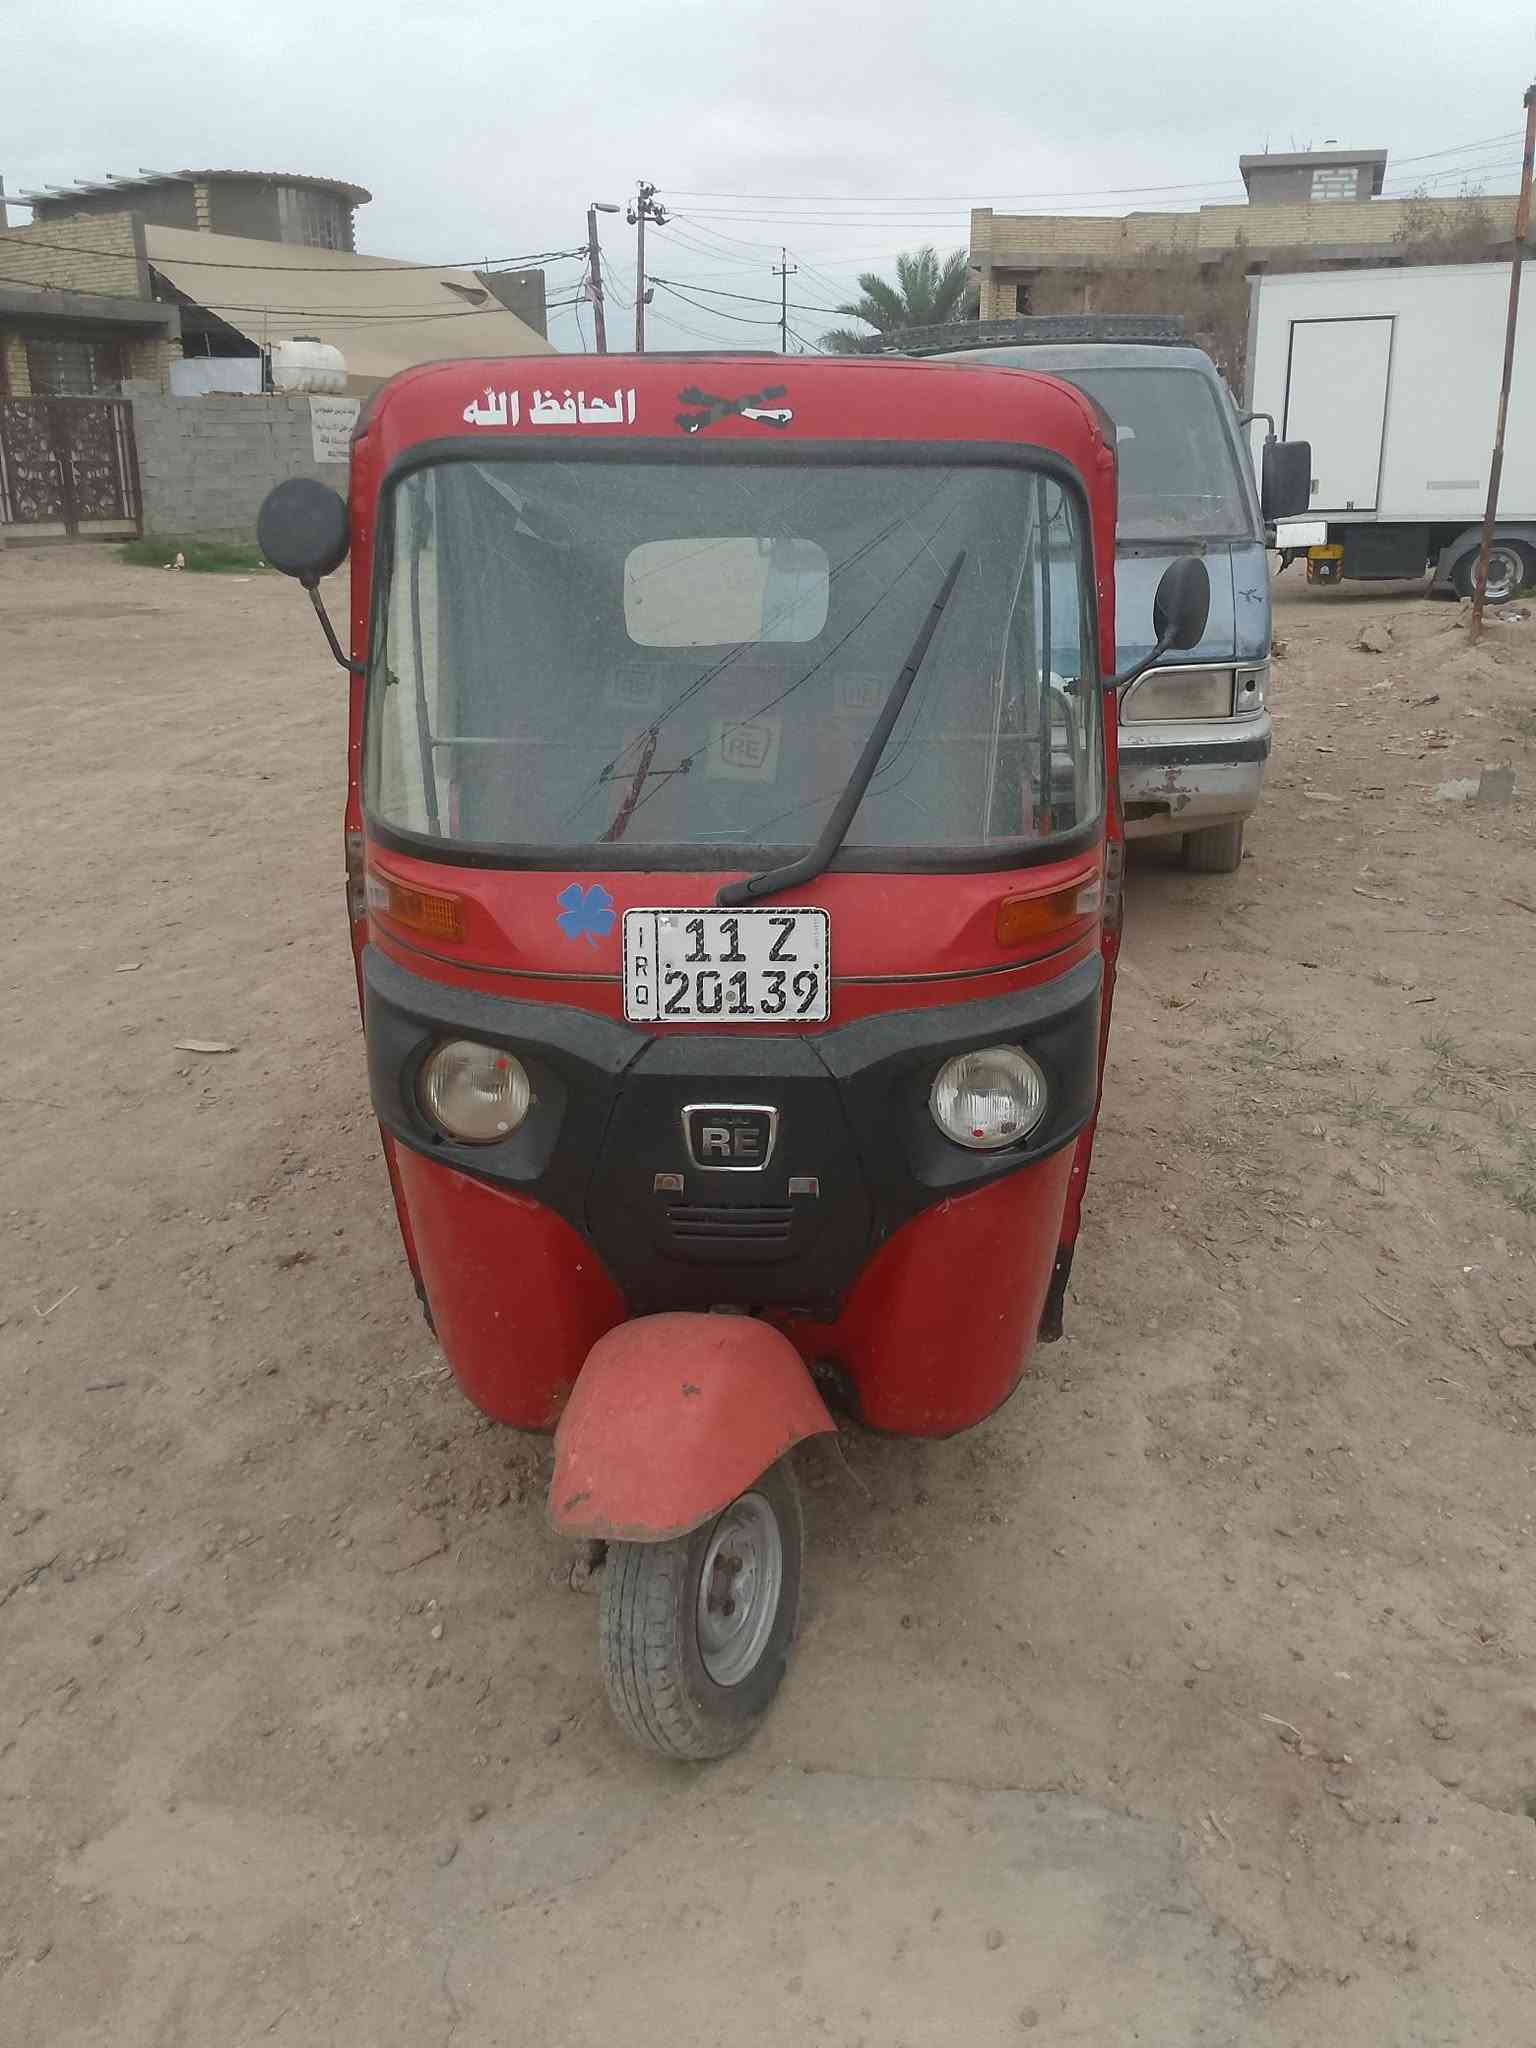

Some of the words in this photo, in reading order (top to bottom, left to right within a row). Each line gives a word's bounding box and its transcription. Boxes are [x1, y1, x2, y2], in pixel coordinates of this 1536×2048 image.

[463, 386, 520, 426] الله
[529, 388, 636, 425] الحافظ
[685, 917, 747, 962] 11
[768, 917, 798, 962] Z
[635, 926, 649, 1005] IRQ
[664, 970, 819, 1014] 20139
[702, 1127, 760, 1156] RE
